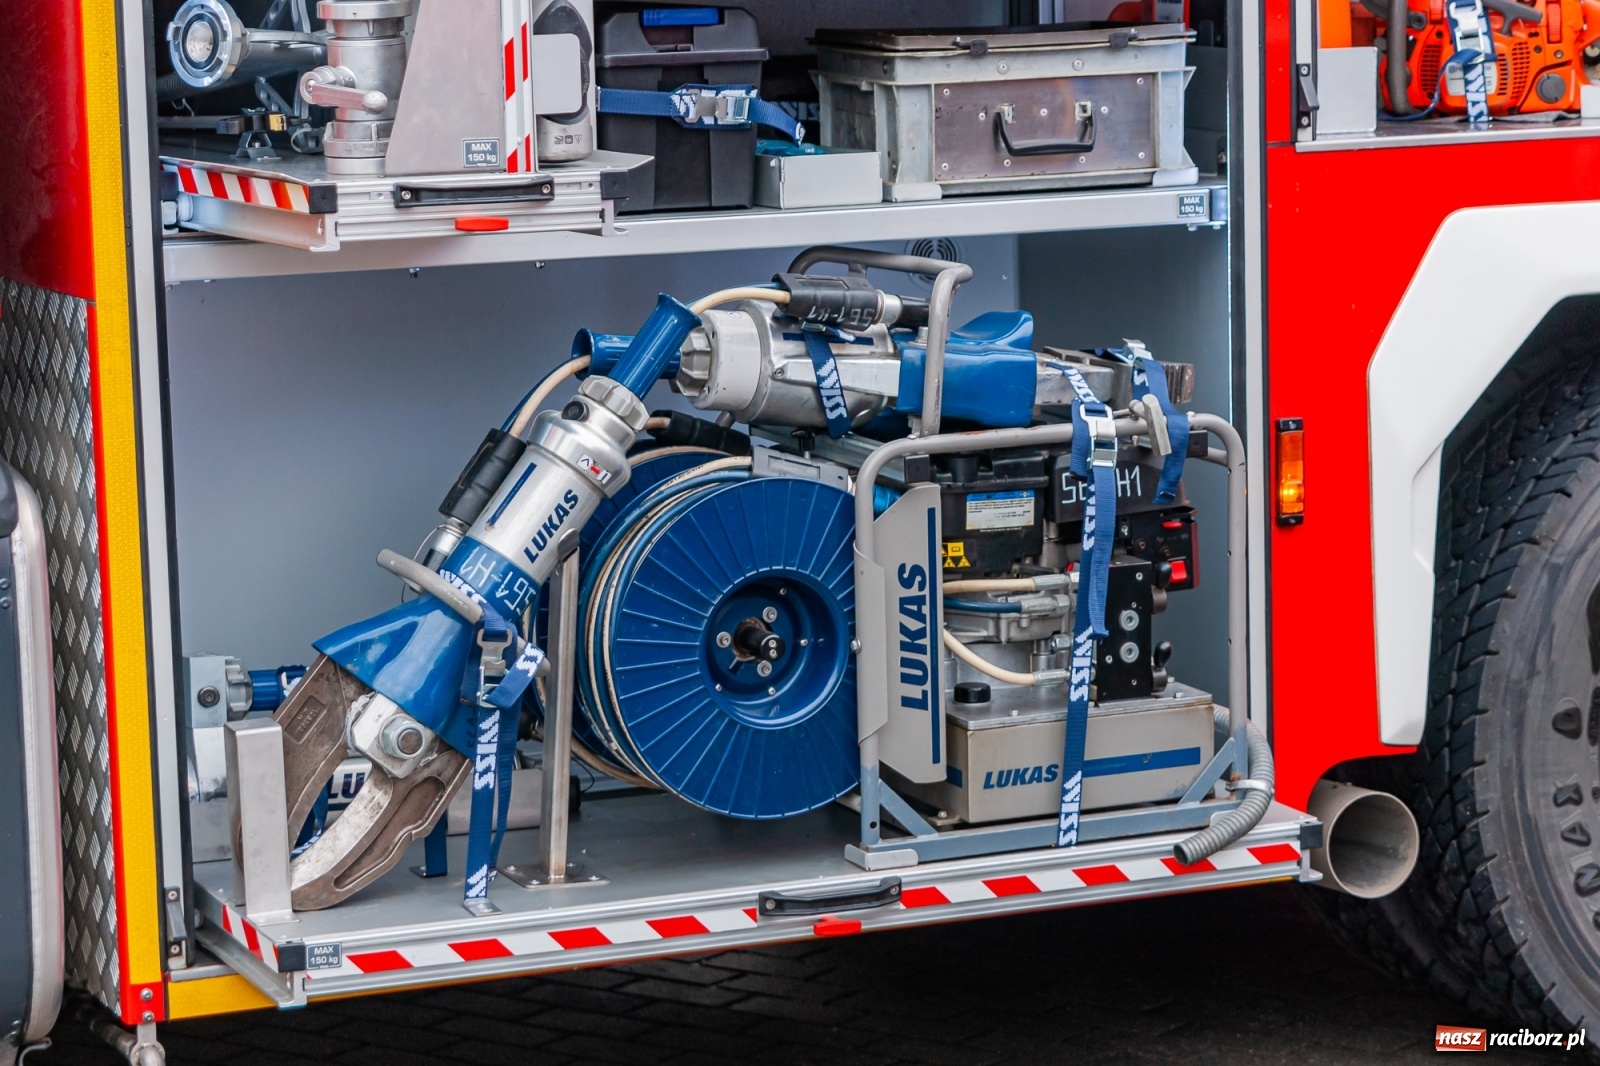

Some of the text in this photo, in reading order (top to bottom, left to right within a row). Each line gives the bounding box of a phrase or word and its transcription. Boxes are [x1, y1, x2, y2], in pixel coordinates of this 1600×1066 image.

[471, 142, 492, 151] MAX
[467, 153, 497, 162] 150 kg
[1183, 196, 1200, 204] MAX
[1180, 205, 1204, 214] 150 kg
[522, 487, 580, 566] LUKAS
[897, 561, 929, 711] LUKAS
[983, 763, 1060, 790] LUKAS
[314, 945, 334, 955] MAX
[310, 955, 339, 965] 150 kg
